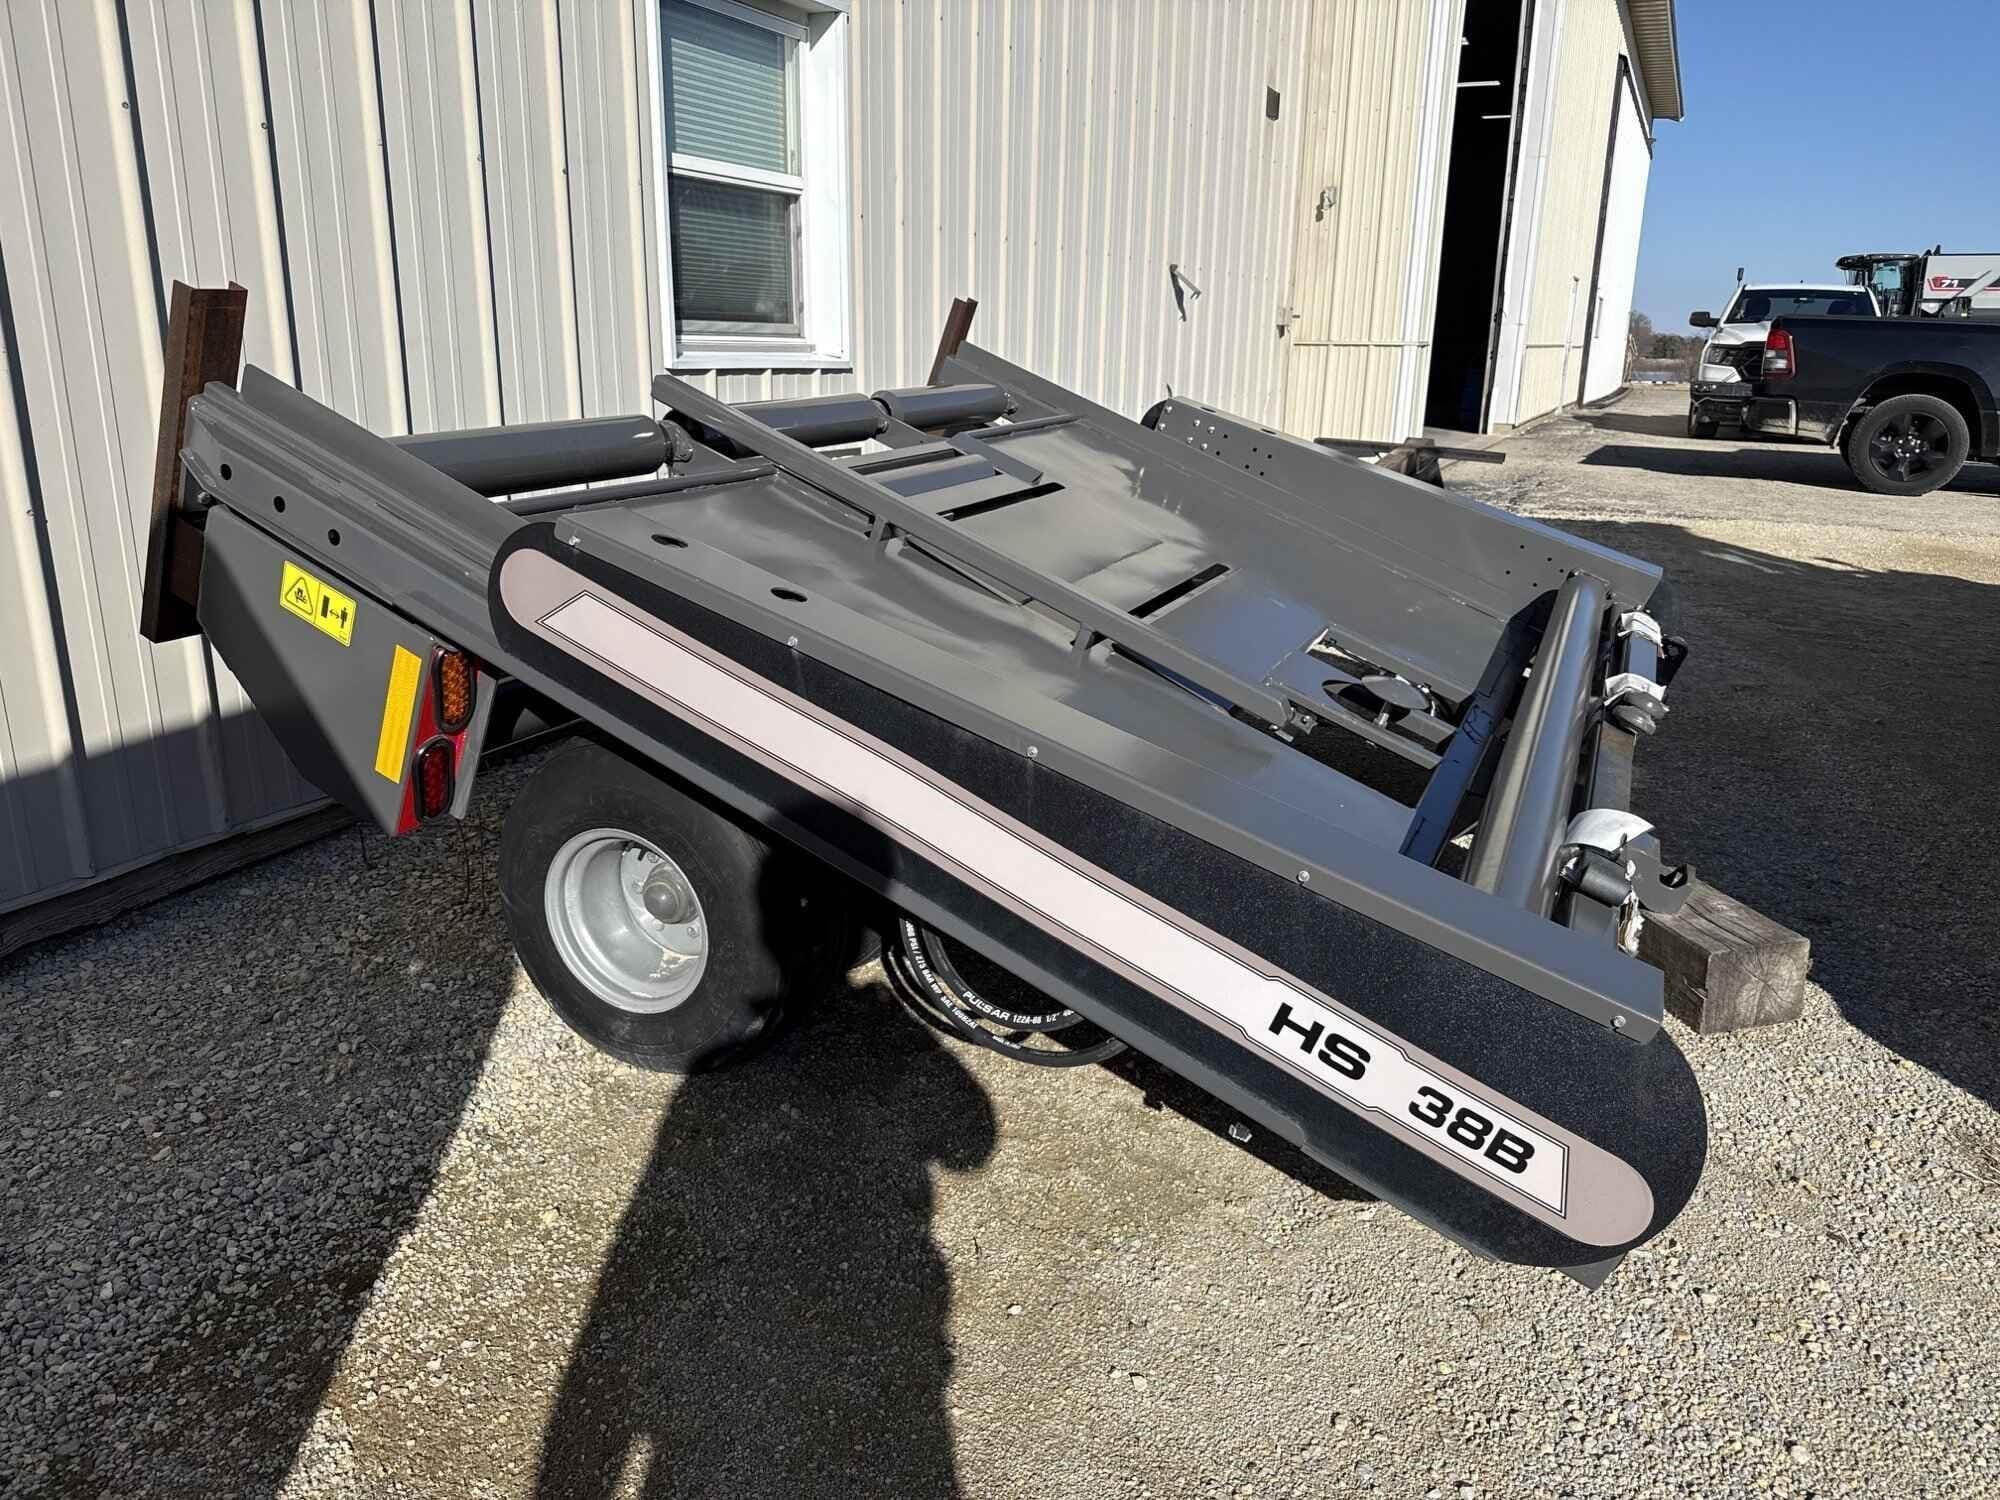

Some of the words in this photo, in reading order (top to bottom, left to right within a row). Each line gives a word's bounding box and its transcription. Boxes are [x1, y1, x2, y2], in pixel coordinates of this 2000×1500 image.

[962, 991, 1011, 1021] PULSAR
[1268, 1002, 1371, 1081] HS
[1408, 1085, 1536, 1175] 38B
